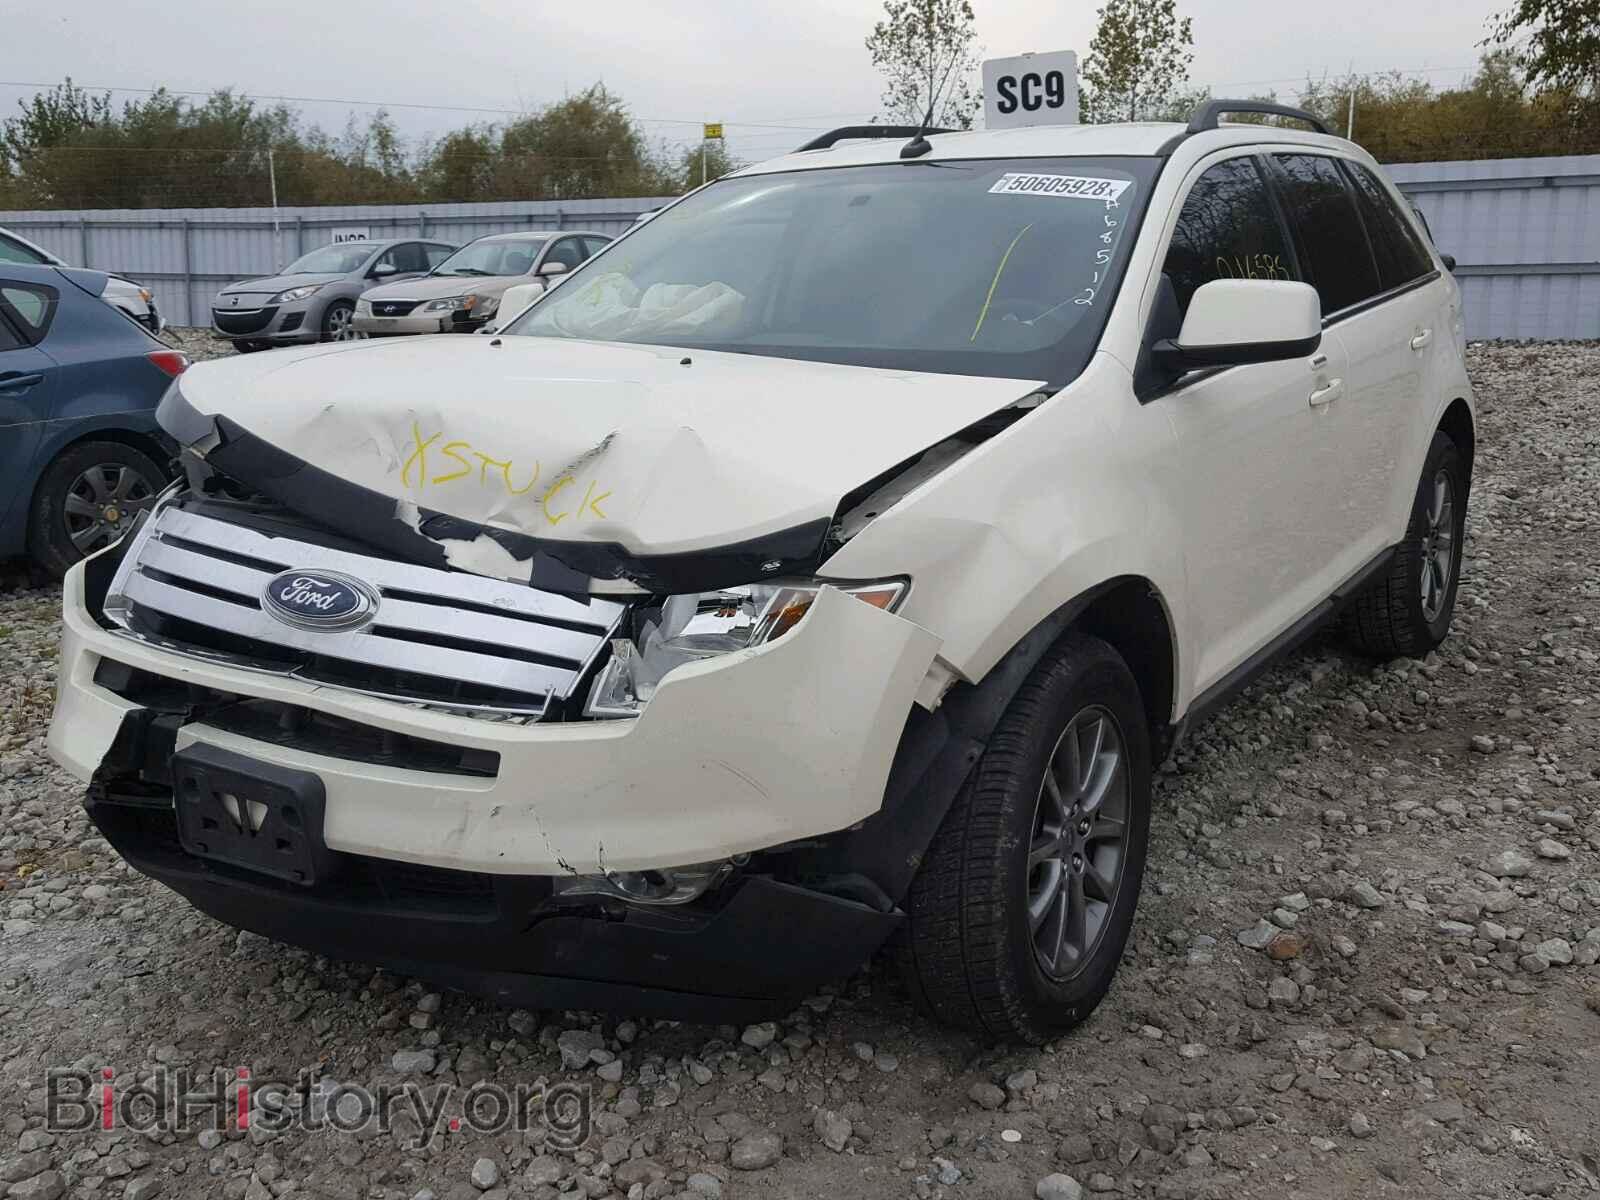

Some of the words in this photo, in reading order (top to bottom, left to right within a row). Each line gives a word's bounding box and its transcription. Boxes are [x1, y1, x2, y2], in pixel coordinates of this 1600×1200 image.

[997, 70, 1064, 114] SC9
[1008, 175, 1113, 196] 50605928
[280, 577, 342, 610] Ford
